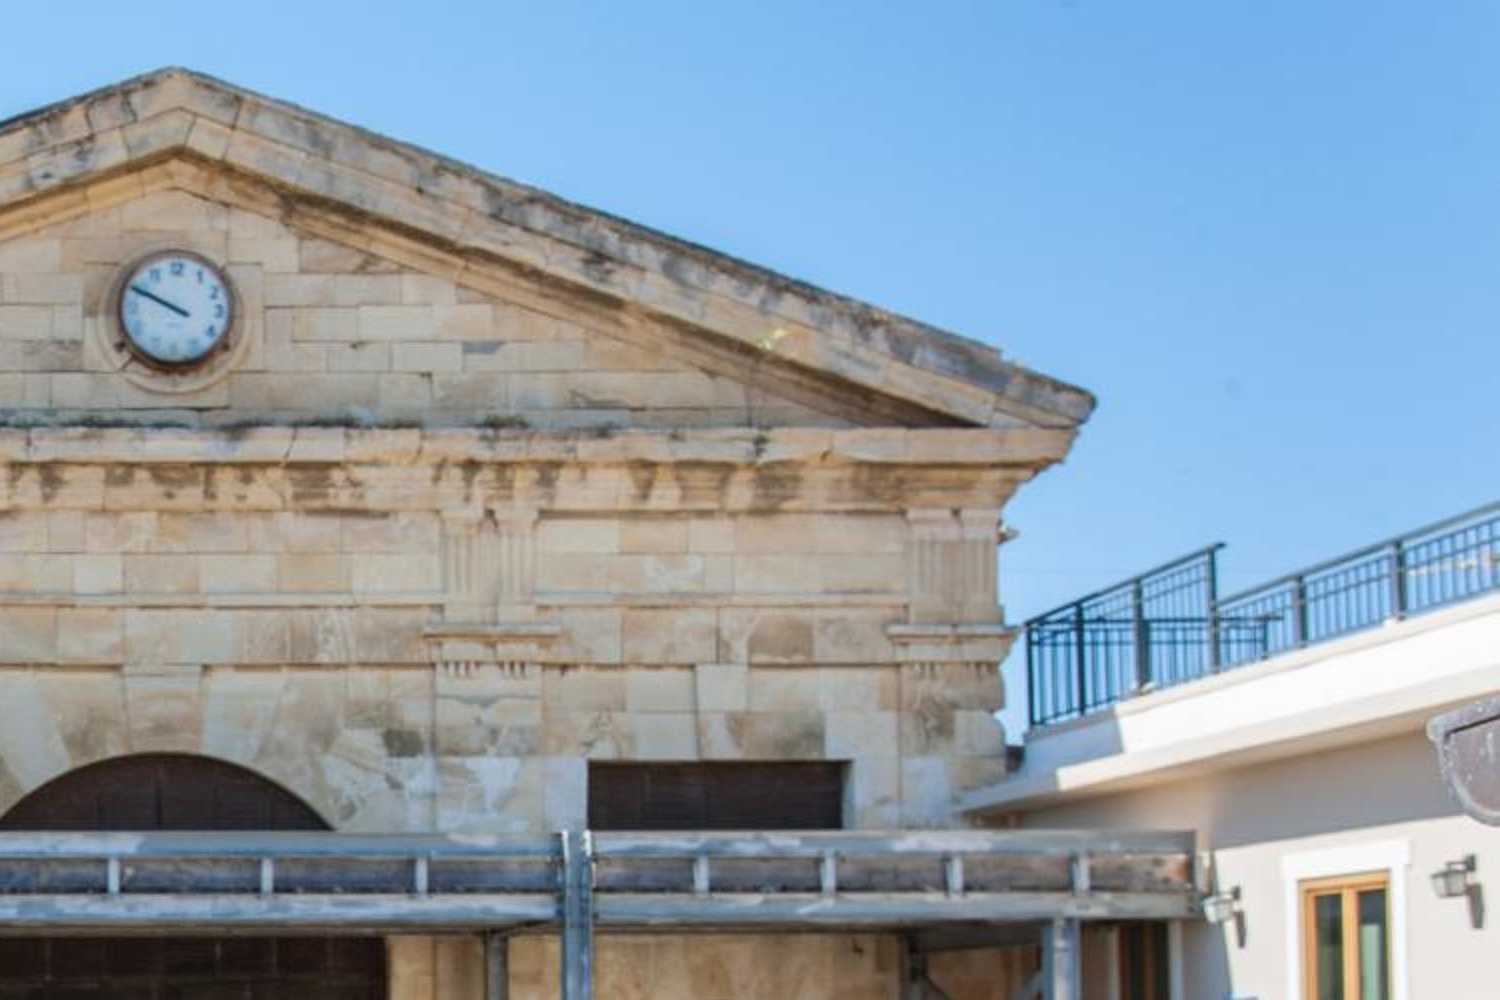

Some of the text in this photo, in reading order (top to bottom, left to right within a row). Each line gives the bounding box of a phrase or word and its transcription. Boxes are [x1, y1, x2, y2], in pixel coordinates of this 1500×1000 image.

[170, 262, 185, 277] 12
[196, 269, 204, 285] 1
[209, 284, 219, 300] 2
[213, 303, 223, 319] 3
[206, 324, 217, 338] 4
